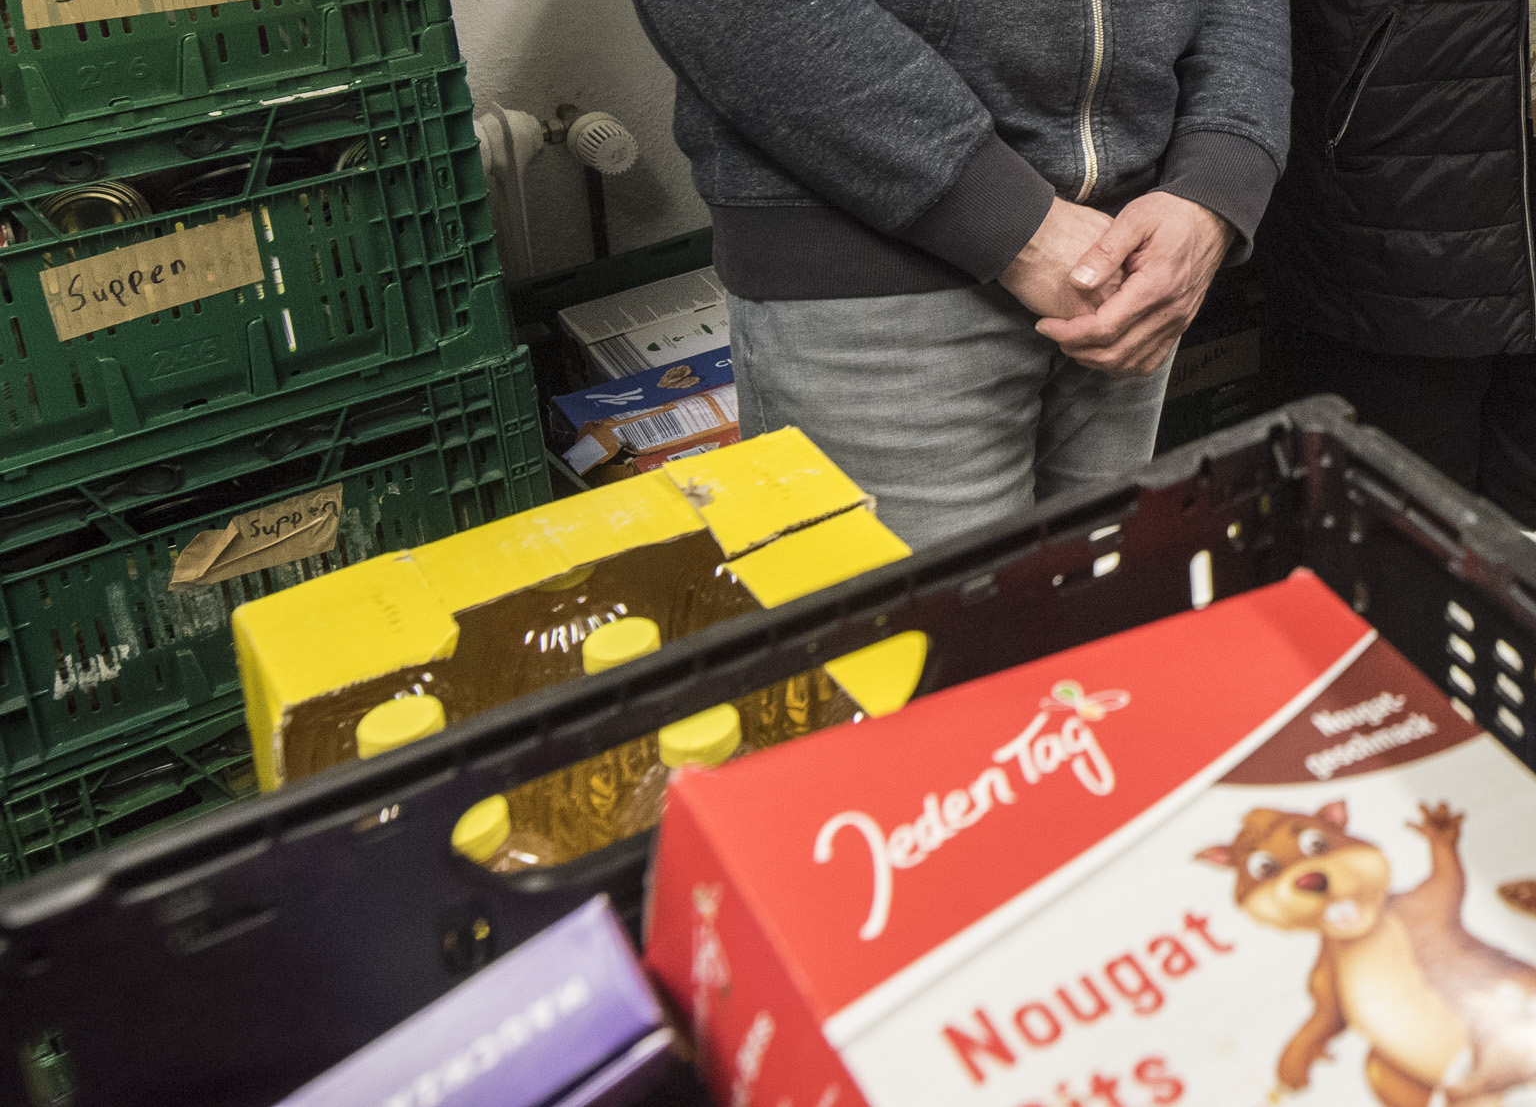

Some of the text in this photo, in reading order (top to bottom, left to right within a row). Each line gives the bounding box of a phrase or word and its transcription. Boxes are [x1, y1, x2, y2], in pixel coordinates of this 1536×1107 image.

[66, 256, 186, 313] Suppen
[813, 761, 1017, 941] Jeden
[991, 709, 1116, 797] Tag
[940, 910, 1236, 1086] Nougat
